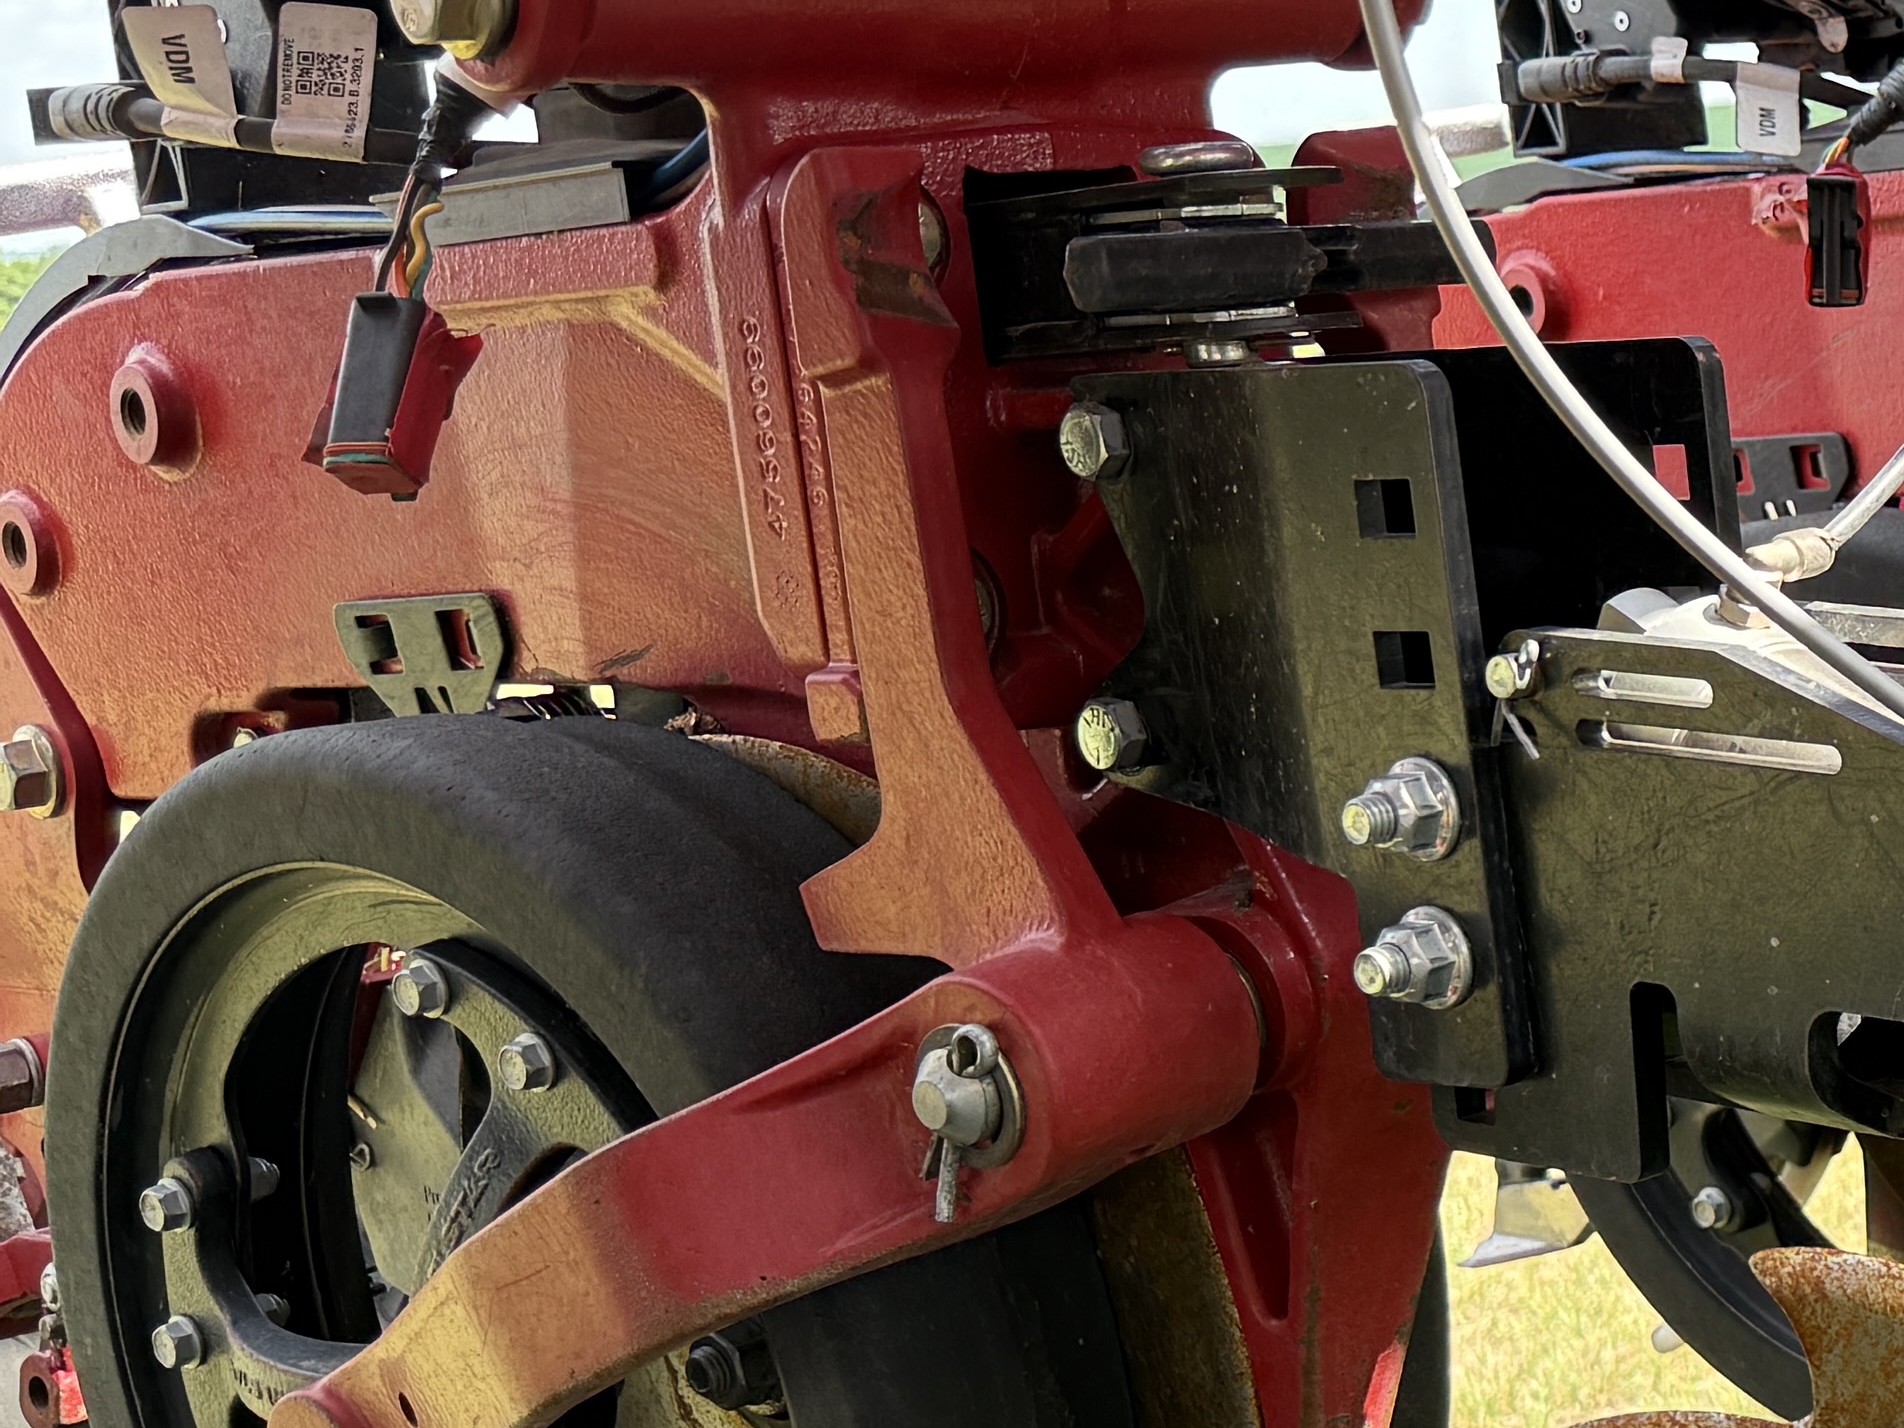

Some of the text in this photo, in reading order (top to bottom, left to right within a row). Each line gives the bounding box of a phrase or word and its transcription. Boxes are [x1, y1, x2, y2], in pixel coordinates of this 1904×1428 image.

[161, 34, 196, 85] VDM
[281, 93, 292, 106] DO
[1759, 107, 1776, 136] VDM
[743, 316, 788, 542] 47560099
